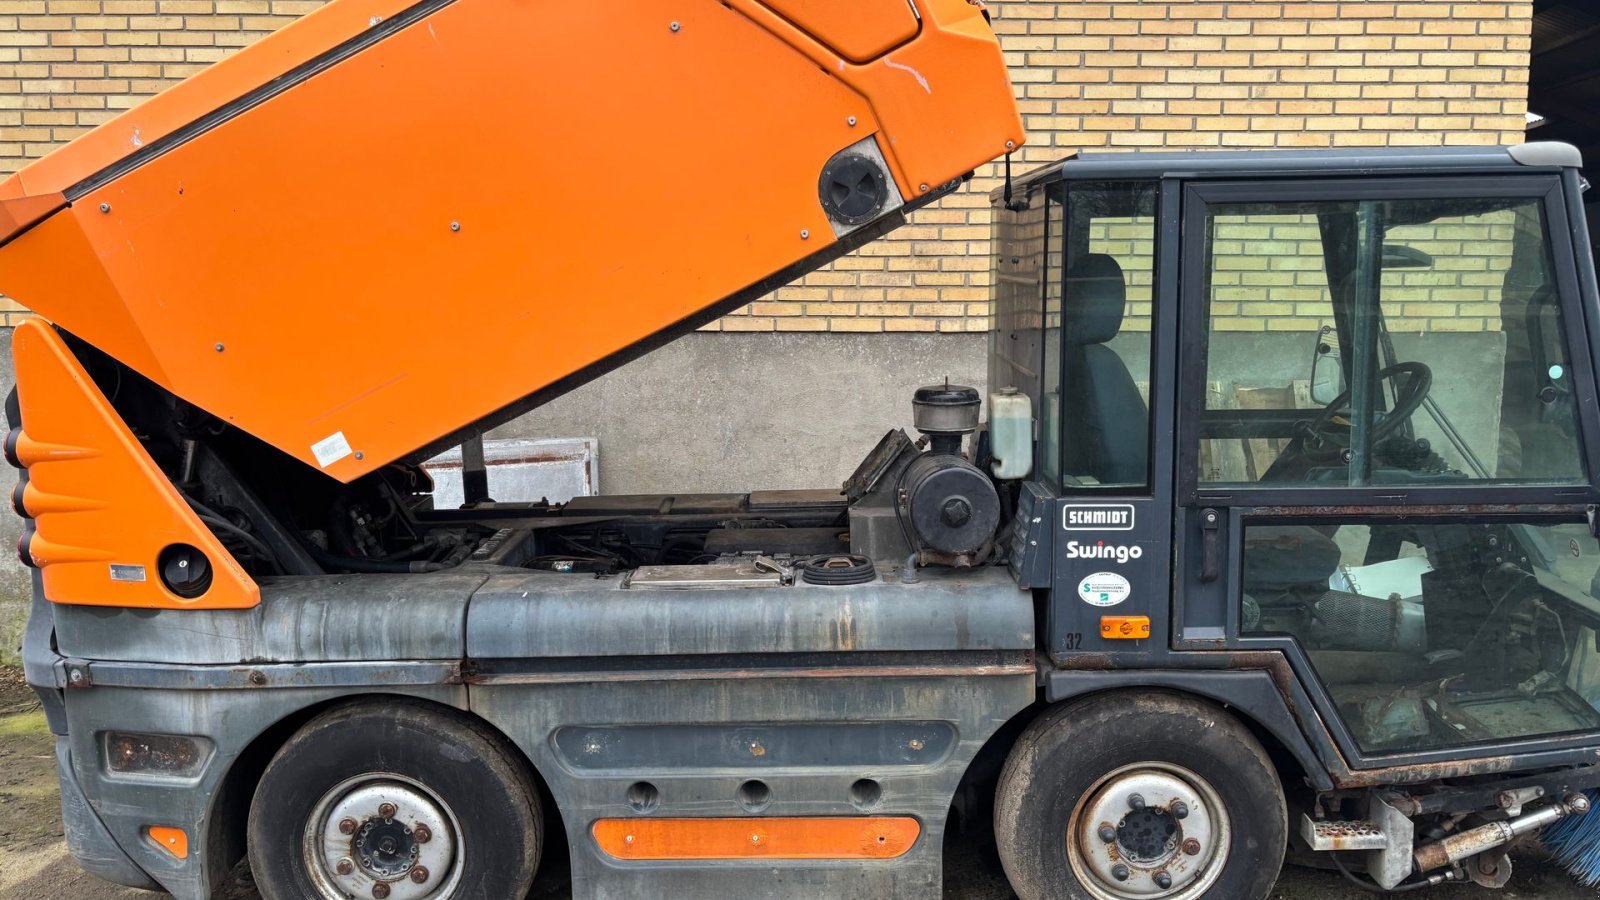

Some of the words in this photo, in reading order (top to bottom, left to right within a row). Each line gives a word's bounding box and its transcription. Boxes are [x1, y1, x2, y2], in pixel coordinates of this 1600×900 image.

[1069, 511, 1128, 524] SCHMIDT
[1066, 540, 1142, 563] Swingo
[1066, 633, 1082, 650] 32
